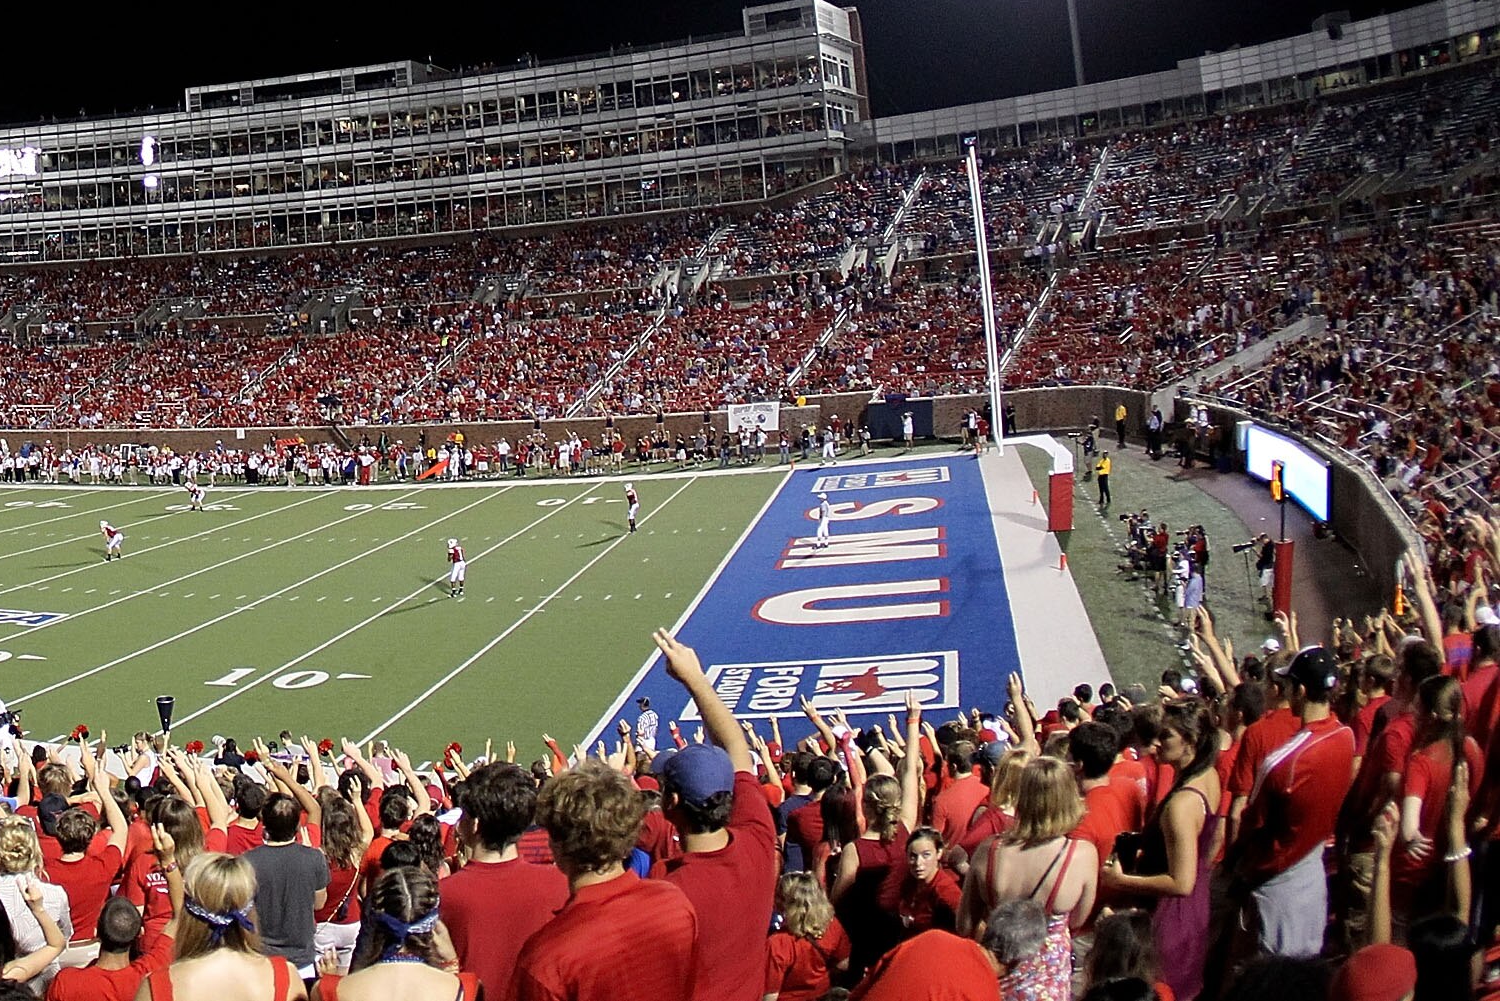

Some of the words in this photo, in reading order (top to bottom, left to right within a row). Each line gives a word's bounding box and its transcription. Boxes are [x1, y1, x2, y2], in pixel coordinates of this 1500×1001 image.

[752, 497, 950, 625] SMU
[203, 667, 330, 689] 10
[748, 666, 805, 711] FORD
